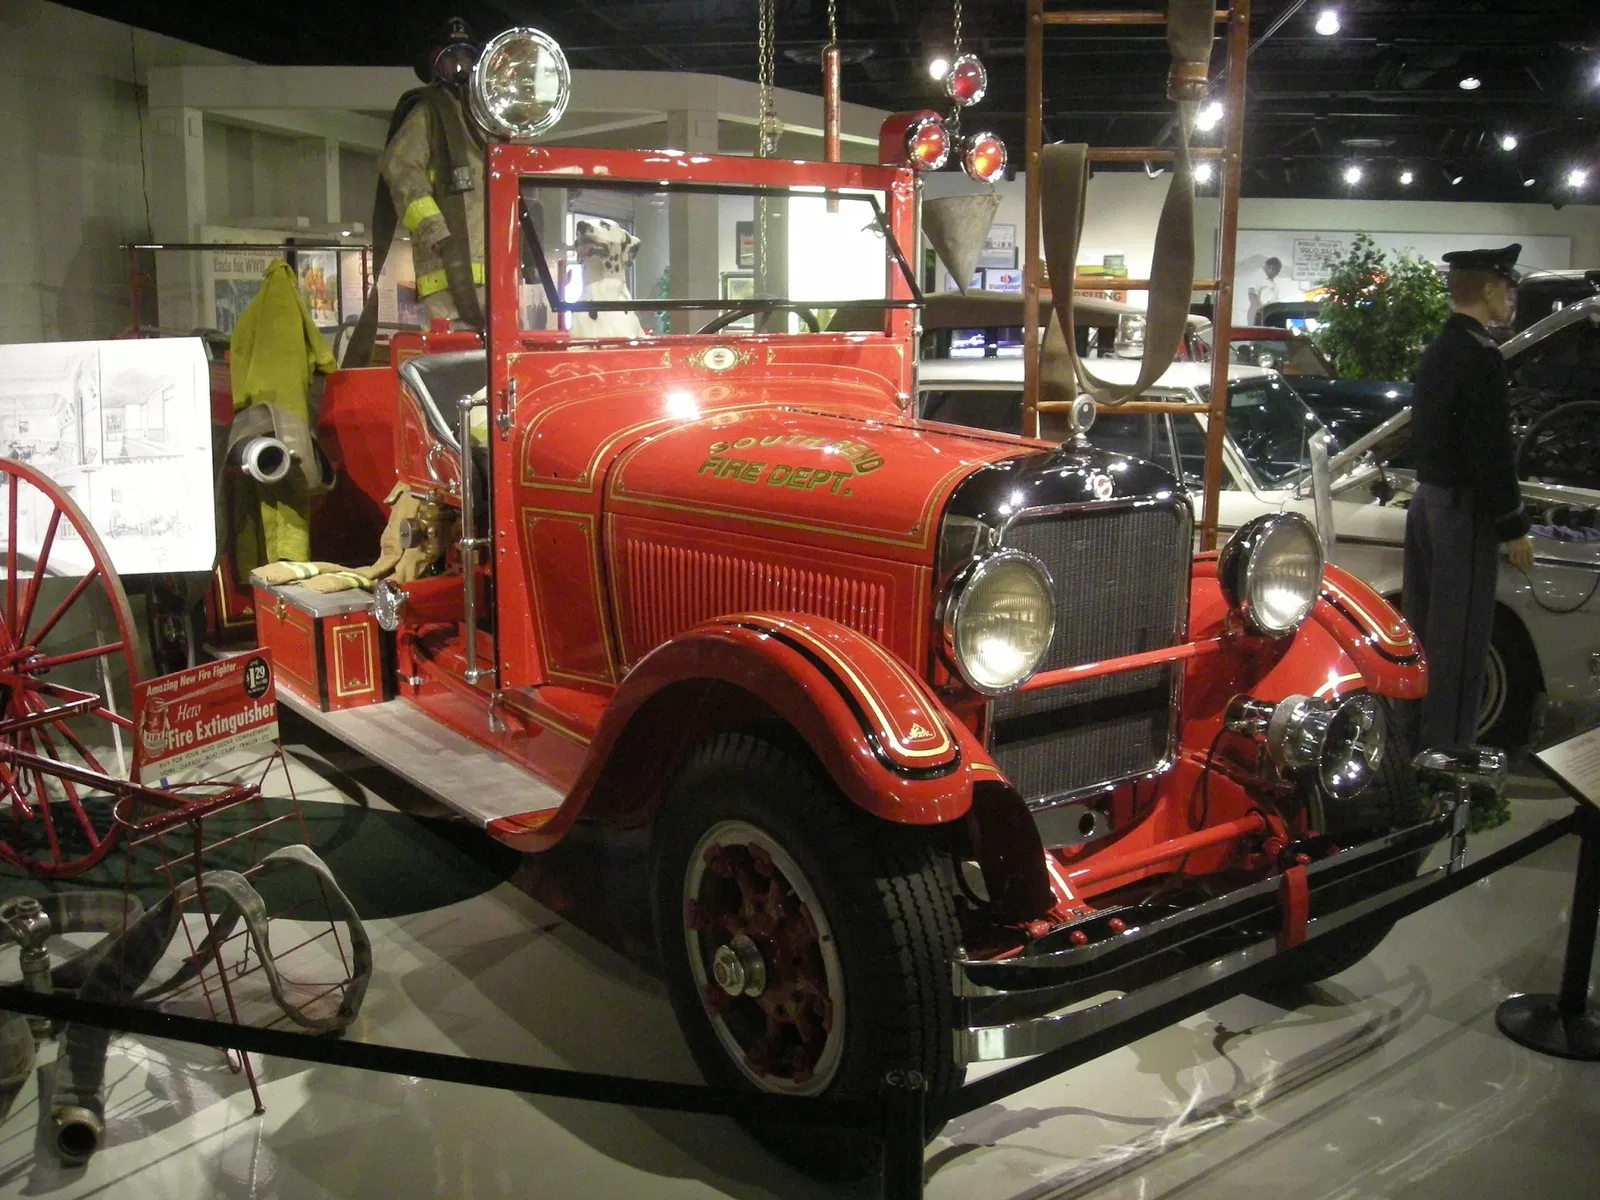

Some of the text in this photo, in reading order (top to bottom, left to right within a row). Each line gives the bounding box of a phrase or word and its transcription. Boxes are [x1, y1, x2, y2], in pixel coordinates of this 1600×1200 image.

[213, 257, 232, 273] Ends
[233, 257, 244, 273] for
[708, 434, 885, 476] SOUTH BEND
[698, 456, 853, 497] FIRE DEPT.
[146, 680, 179, 698] Amazing
[180, 674, 196, 687] New
[198, 668, 212, 681] Fire
[168, 701, 276, 750] Fire Extinguisher
[176, 703, 201, 723] Hero
[160, 767, 176, 776] HOME
[180, 759, 201, 770] GARAGE
[205, 751, 218, 760] BOAT
[221, 746, 236, 755] CAMP
[239, 737, 258, 749] TRAILER
[172, 756, 183, 765] FOR
[185, 751, 199, 760] YOUR
[201, 745, 215, 754] AUTO
[216, 739, 233, 749] GLOVE
[235, 727, 271, 742] COMPARTMENT
